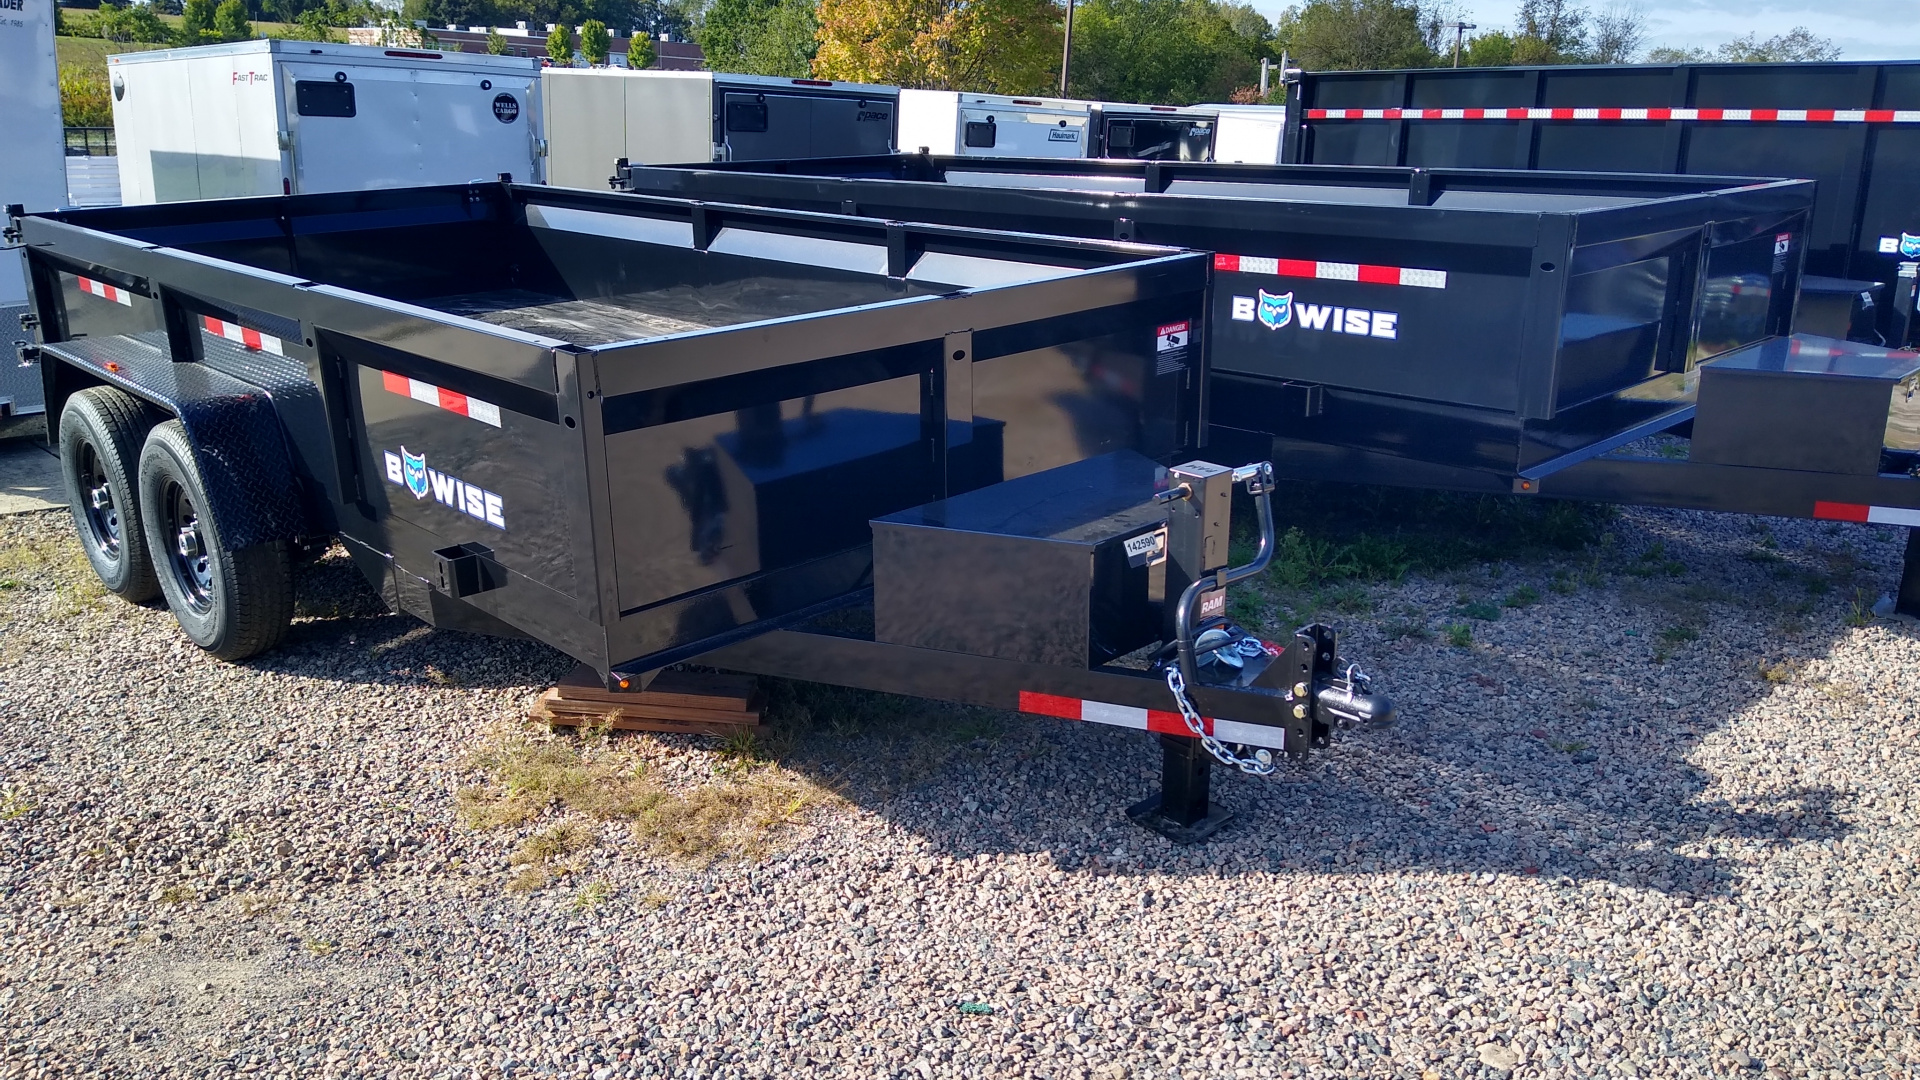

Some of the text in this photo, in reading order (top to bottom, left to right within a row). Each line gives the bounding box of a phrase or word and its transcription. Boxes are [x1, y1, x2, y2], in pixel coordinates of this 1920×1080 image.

[495, 101, 517, 109] WELLS
[495, 107, 517, 115] CARGO
[1165, 323, 1186, 334] DANGER
[1127, 536, 1156, 553] 142590
[1201, 595, 1224, 614] RAM
